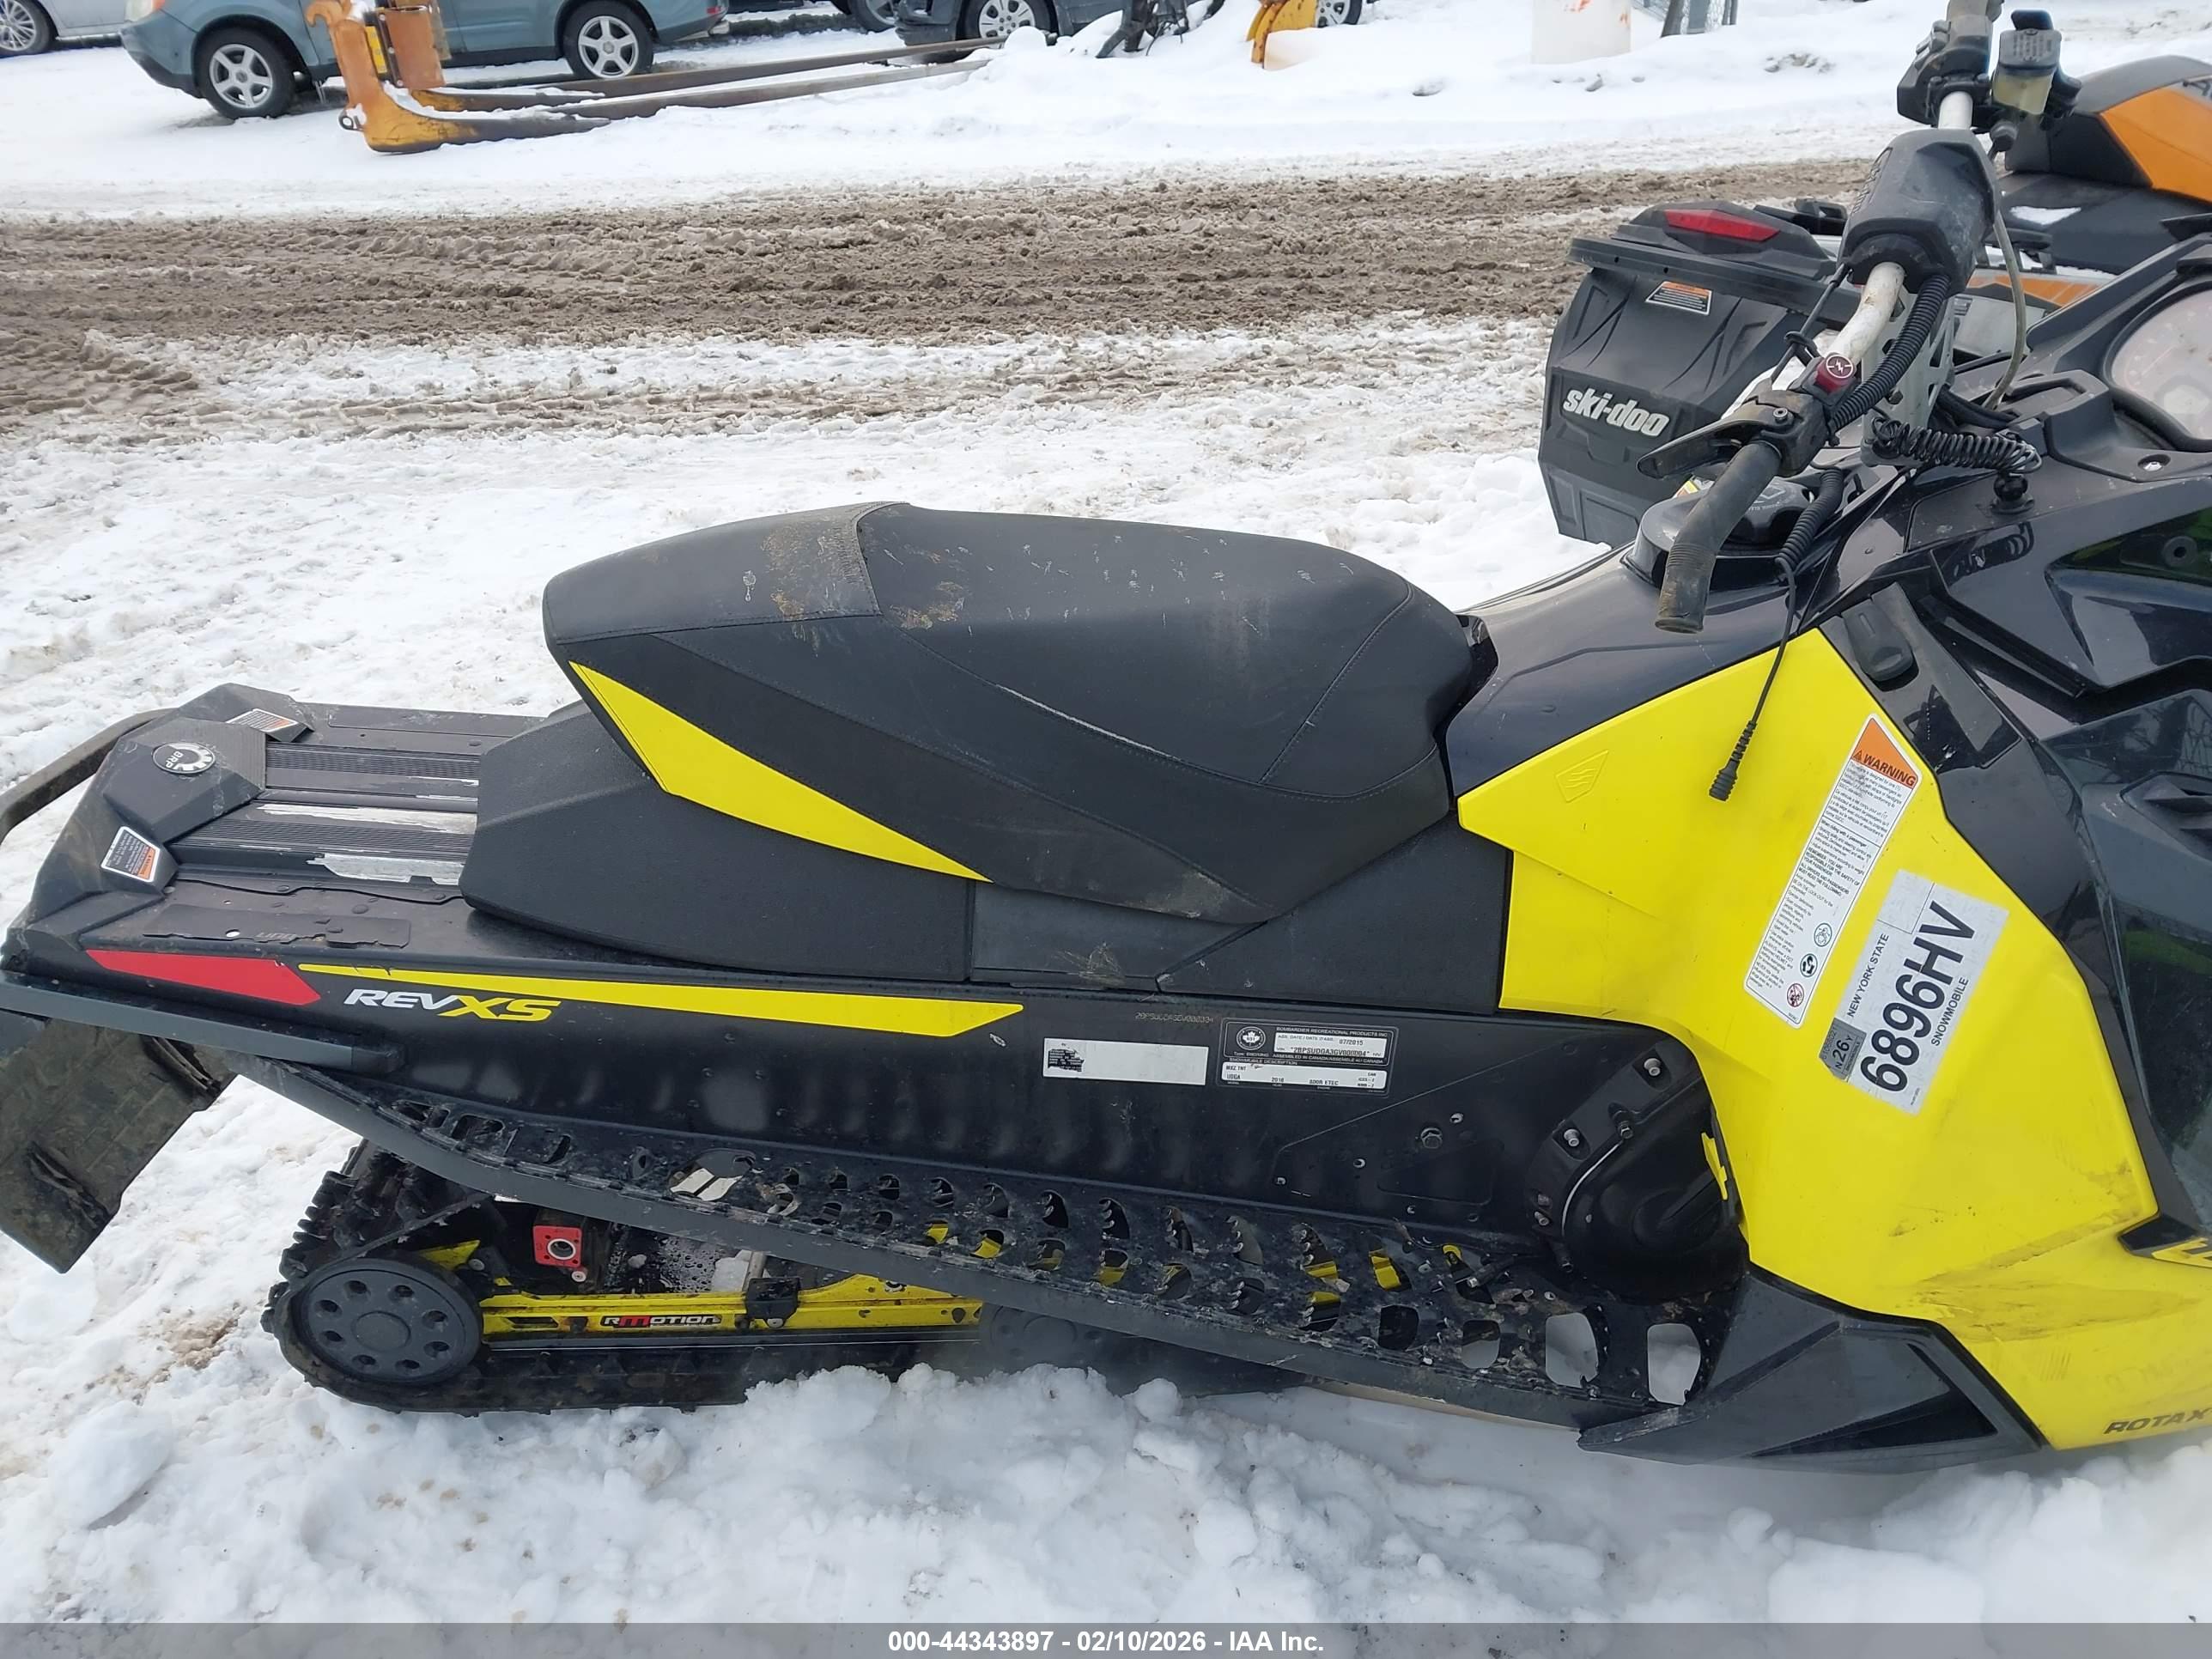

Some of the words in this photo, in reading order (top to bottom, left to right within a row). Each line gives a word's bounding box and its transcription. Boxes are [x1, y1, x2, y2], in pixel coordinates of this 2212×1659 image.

[1563, 388, 1670, 436] ski-doo
[166, 750, 184, 769] BRP
[1862, 752, 1917, 787] WARNING
[1845, 992, 1863, 1018] NEW
[1856, 963, 1875, 994] YORK
[1869, 932, 1889, 964] STATE
[1859, 899, 1976, 1092] 6896HV
[1929, 976, 1969, 1047] SNOWMOBILE
[1831, 1039, 1850, 1062] 26
[2103, 1407, 2212, 1435] ROTAX
